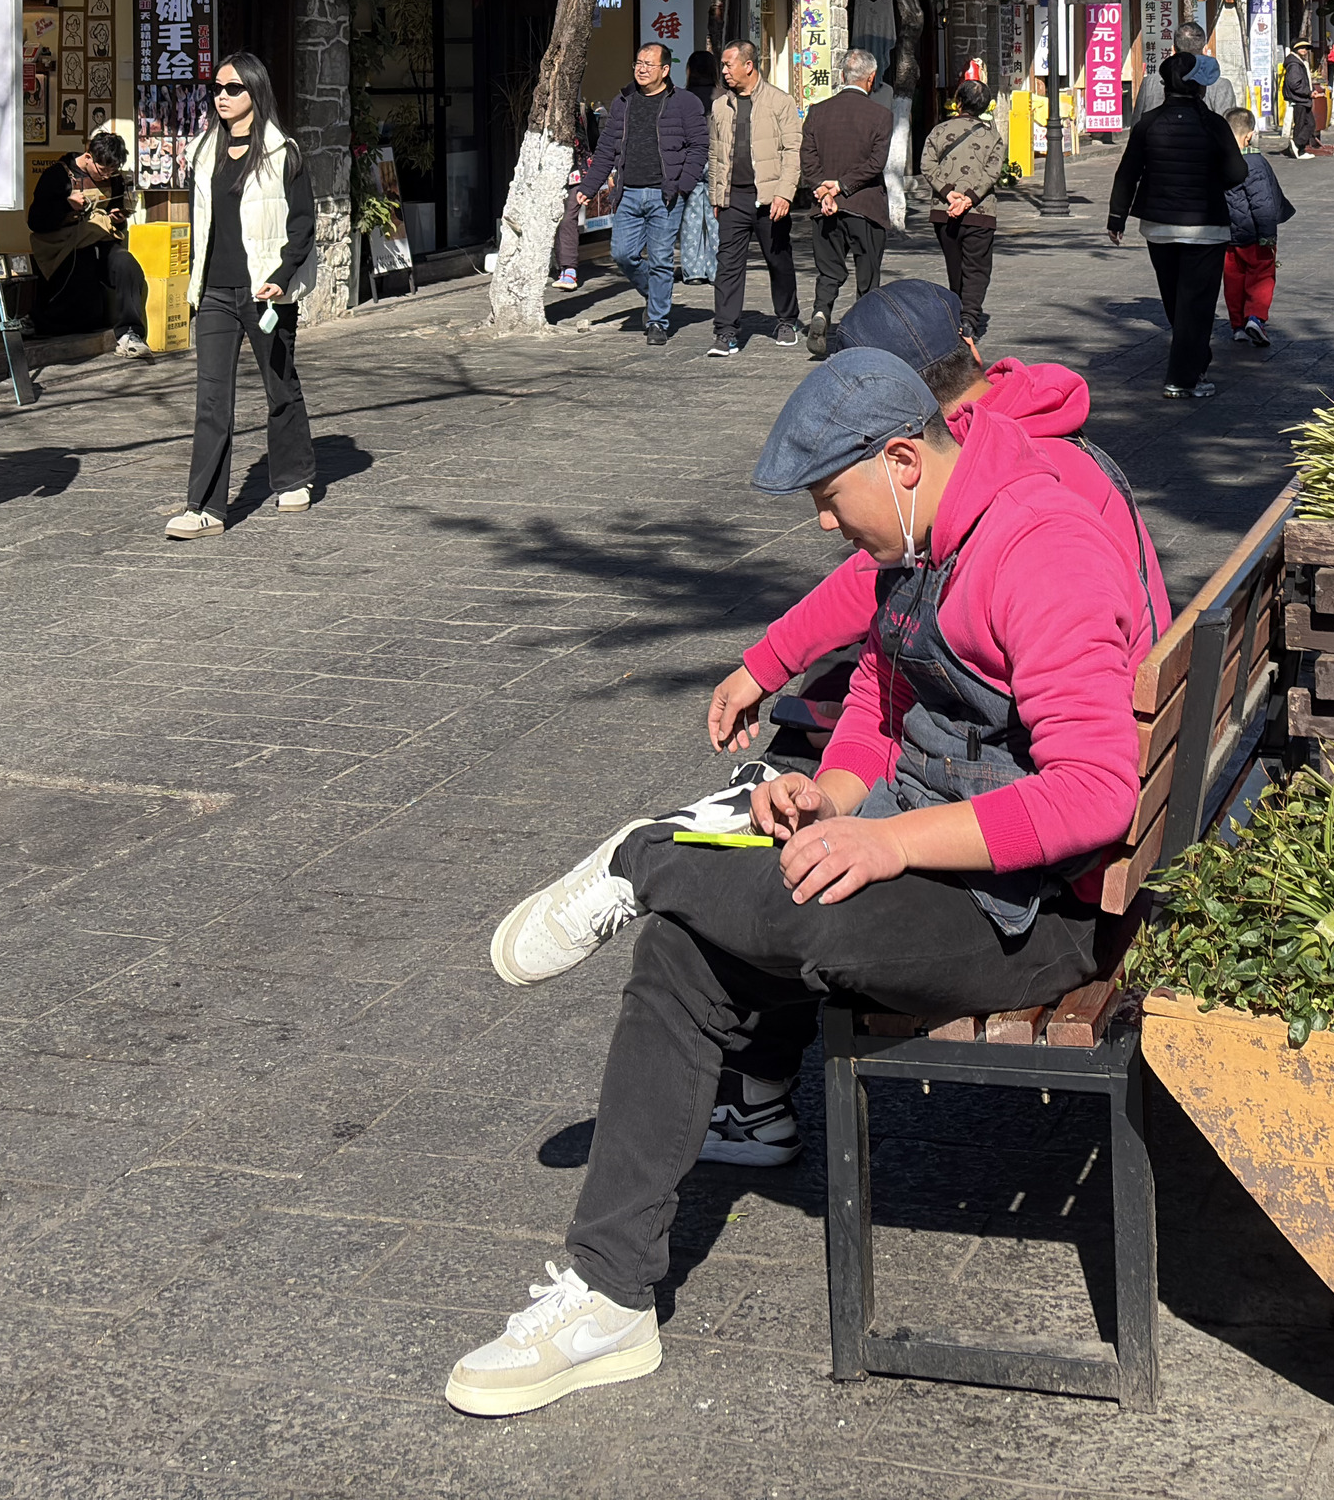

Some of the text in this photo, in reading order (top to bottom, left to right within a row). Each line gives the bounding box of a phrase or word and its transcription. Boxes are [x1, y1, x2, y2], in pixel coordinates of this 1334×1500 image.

[806, 29, 830, 87] 瓦猫
[1087, 8, 1120, 114] 100元15盒包邮
[1145, 1, 1157, 75] 纯手工 鲜花饼
